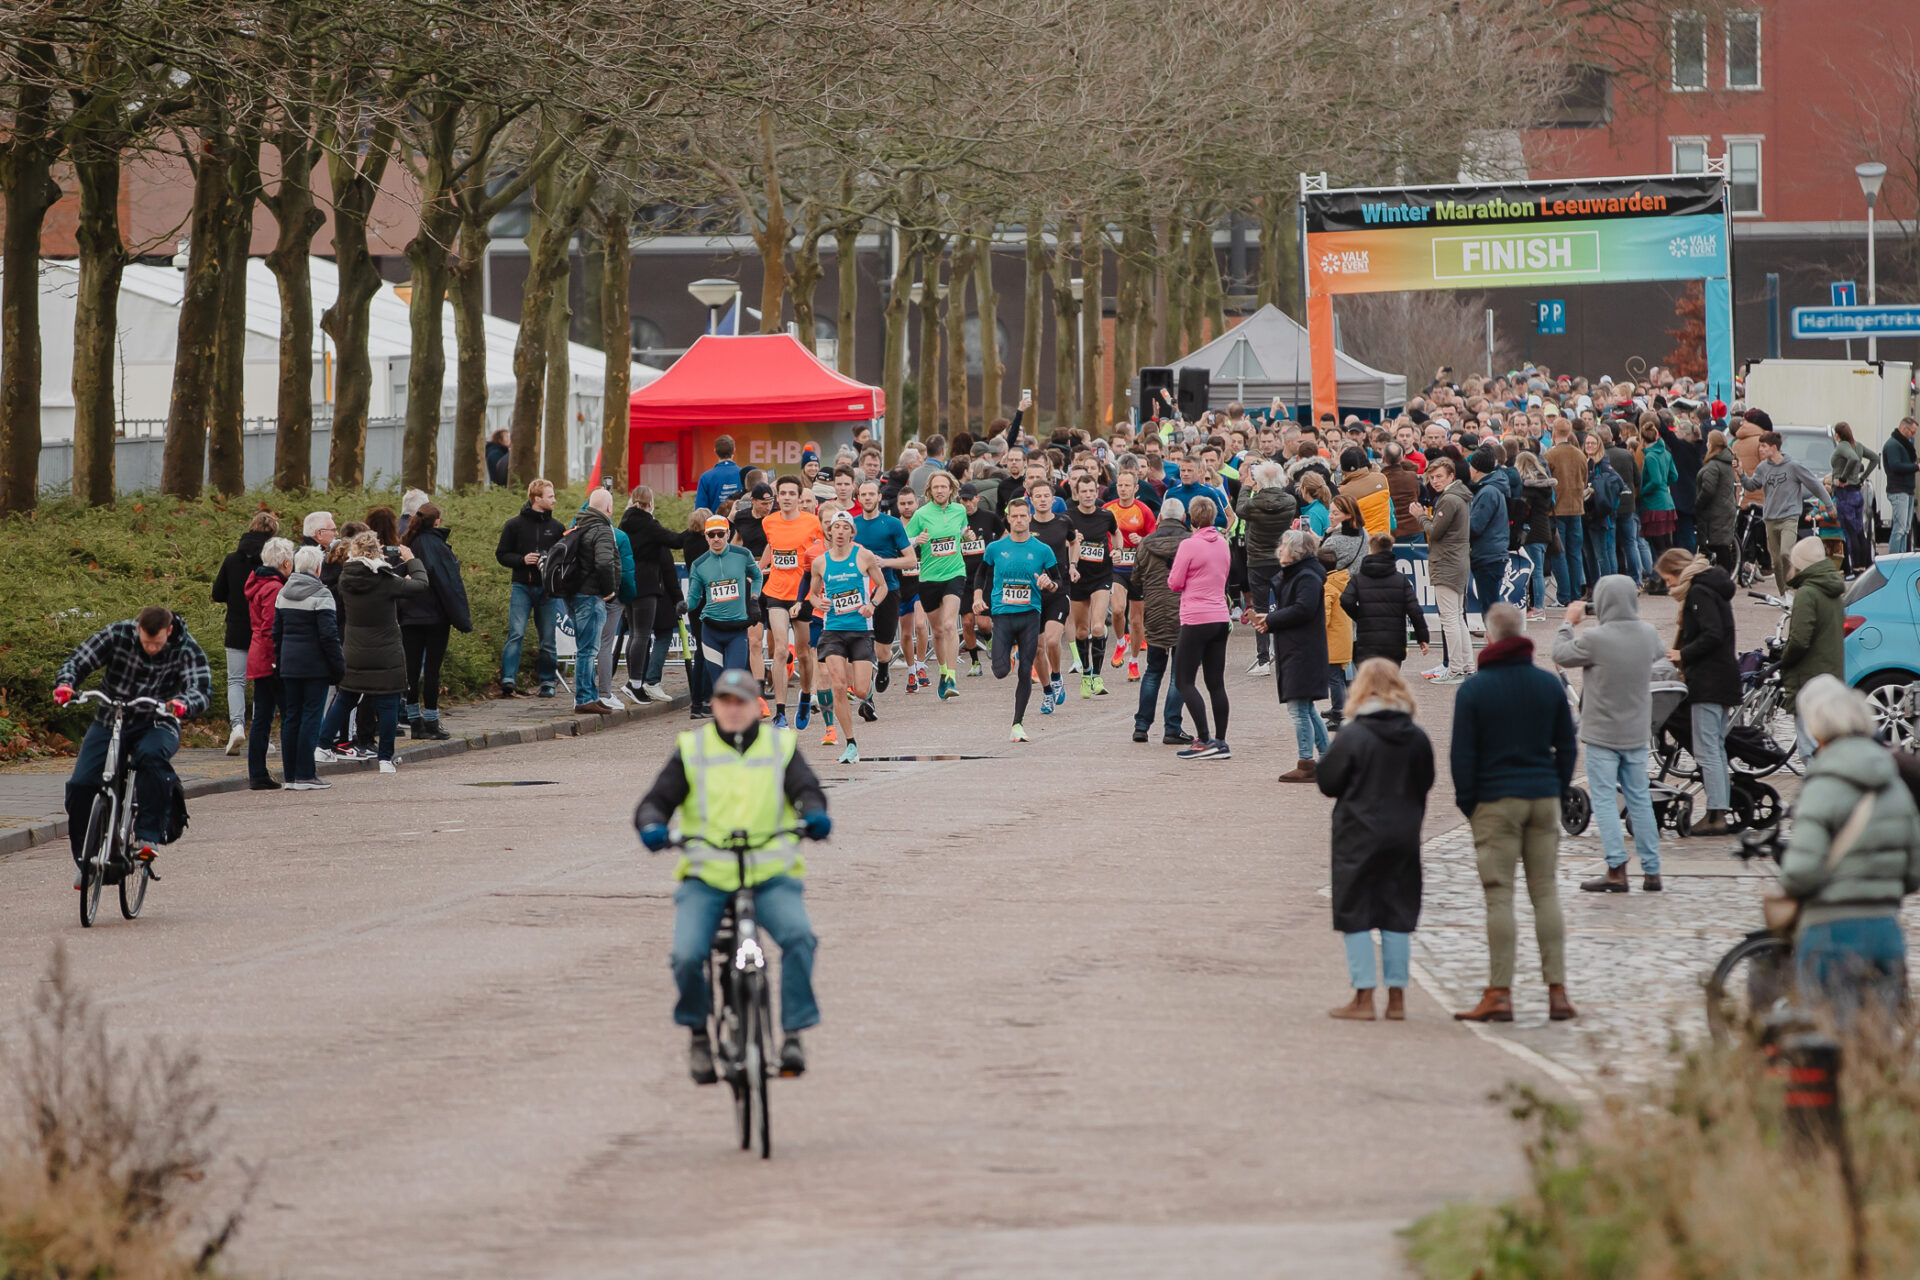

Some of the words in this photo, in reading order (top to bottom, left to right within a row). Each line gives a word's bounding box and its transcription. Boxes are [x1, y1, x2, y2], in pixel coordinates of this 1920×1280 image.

[1361, 202, 1430, 223] Winter
[1435, 197, 1535, 220] Marathon
[1540, 191, 1667, 216] Leeuwarden
[1690, 234, 1717, 246] VALK
[1462, 237, 1572, 271] FINISH
[1690, 244, 1717, 254] EVENT
[1341, 251, 1369, 262] VALK
[1342, 261, 1369, 271] EVENT
[932, 541, 955, 552] 2307
[962, 541, 983, 551] 4221
[1080, 546, 1103, 557] 2346
[773, 555, 796, 565] 2269
[712, 585, 737, 597] 4179
[1004, 589, 1029, 599] 4102
[835, 594, 860, 609] 4242
